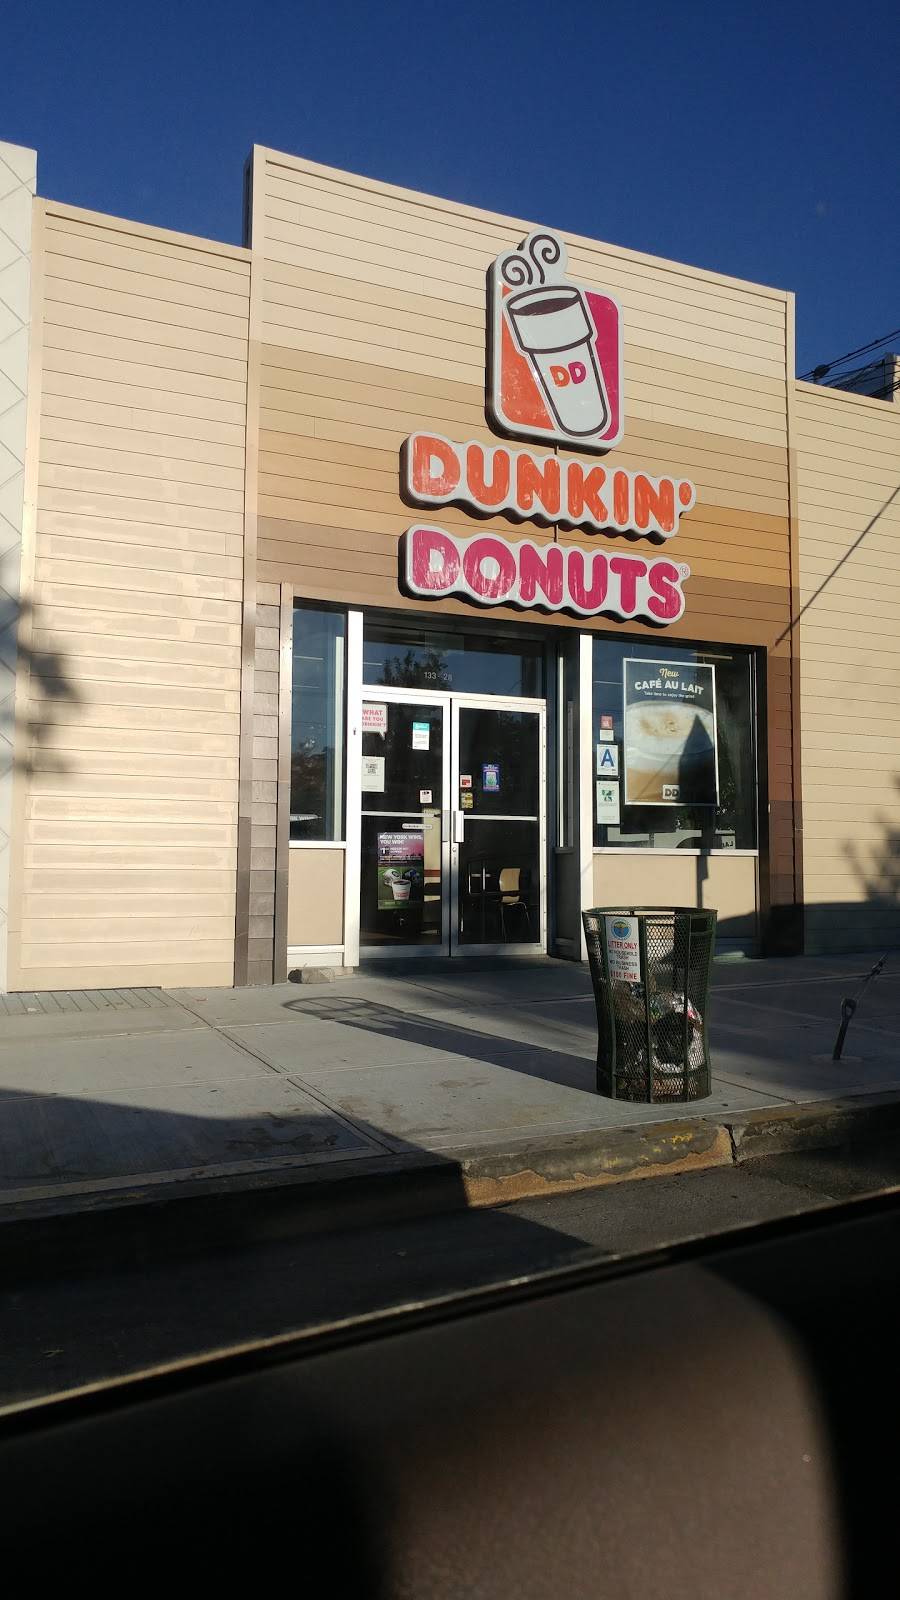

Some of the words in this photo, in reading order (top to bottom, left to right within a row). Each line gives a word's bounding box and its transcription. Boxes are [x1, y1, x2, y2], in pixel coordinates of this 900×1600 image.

[548, 361, 587, 387] DD
[412, 434, 693, 533] DUNKIN'
[411, 529, 682, 619] DONUTS
[659, 668, 680, 678] New
[634, 679, 662, 690] CAFÉ
[664, 680, 679, 690] AU
[681, 682, 705, 695] LAIT
[600, 748, 614, 767] A
[664, 788, 680, 798] DD
[608, 940, 623, 949] LITTER
[623, 971, 638, 980] FINE
